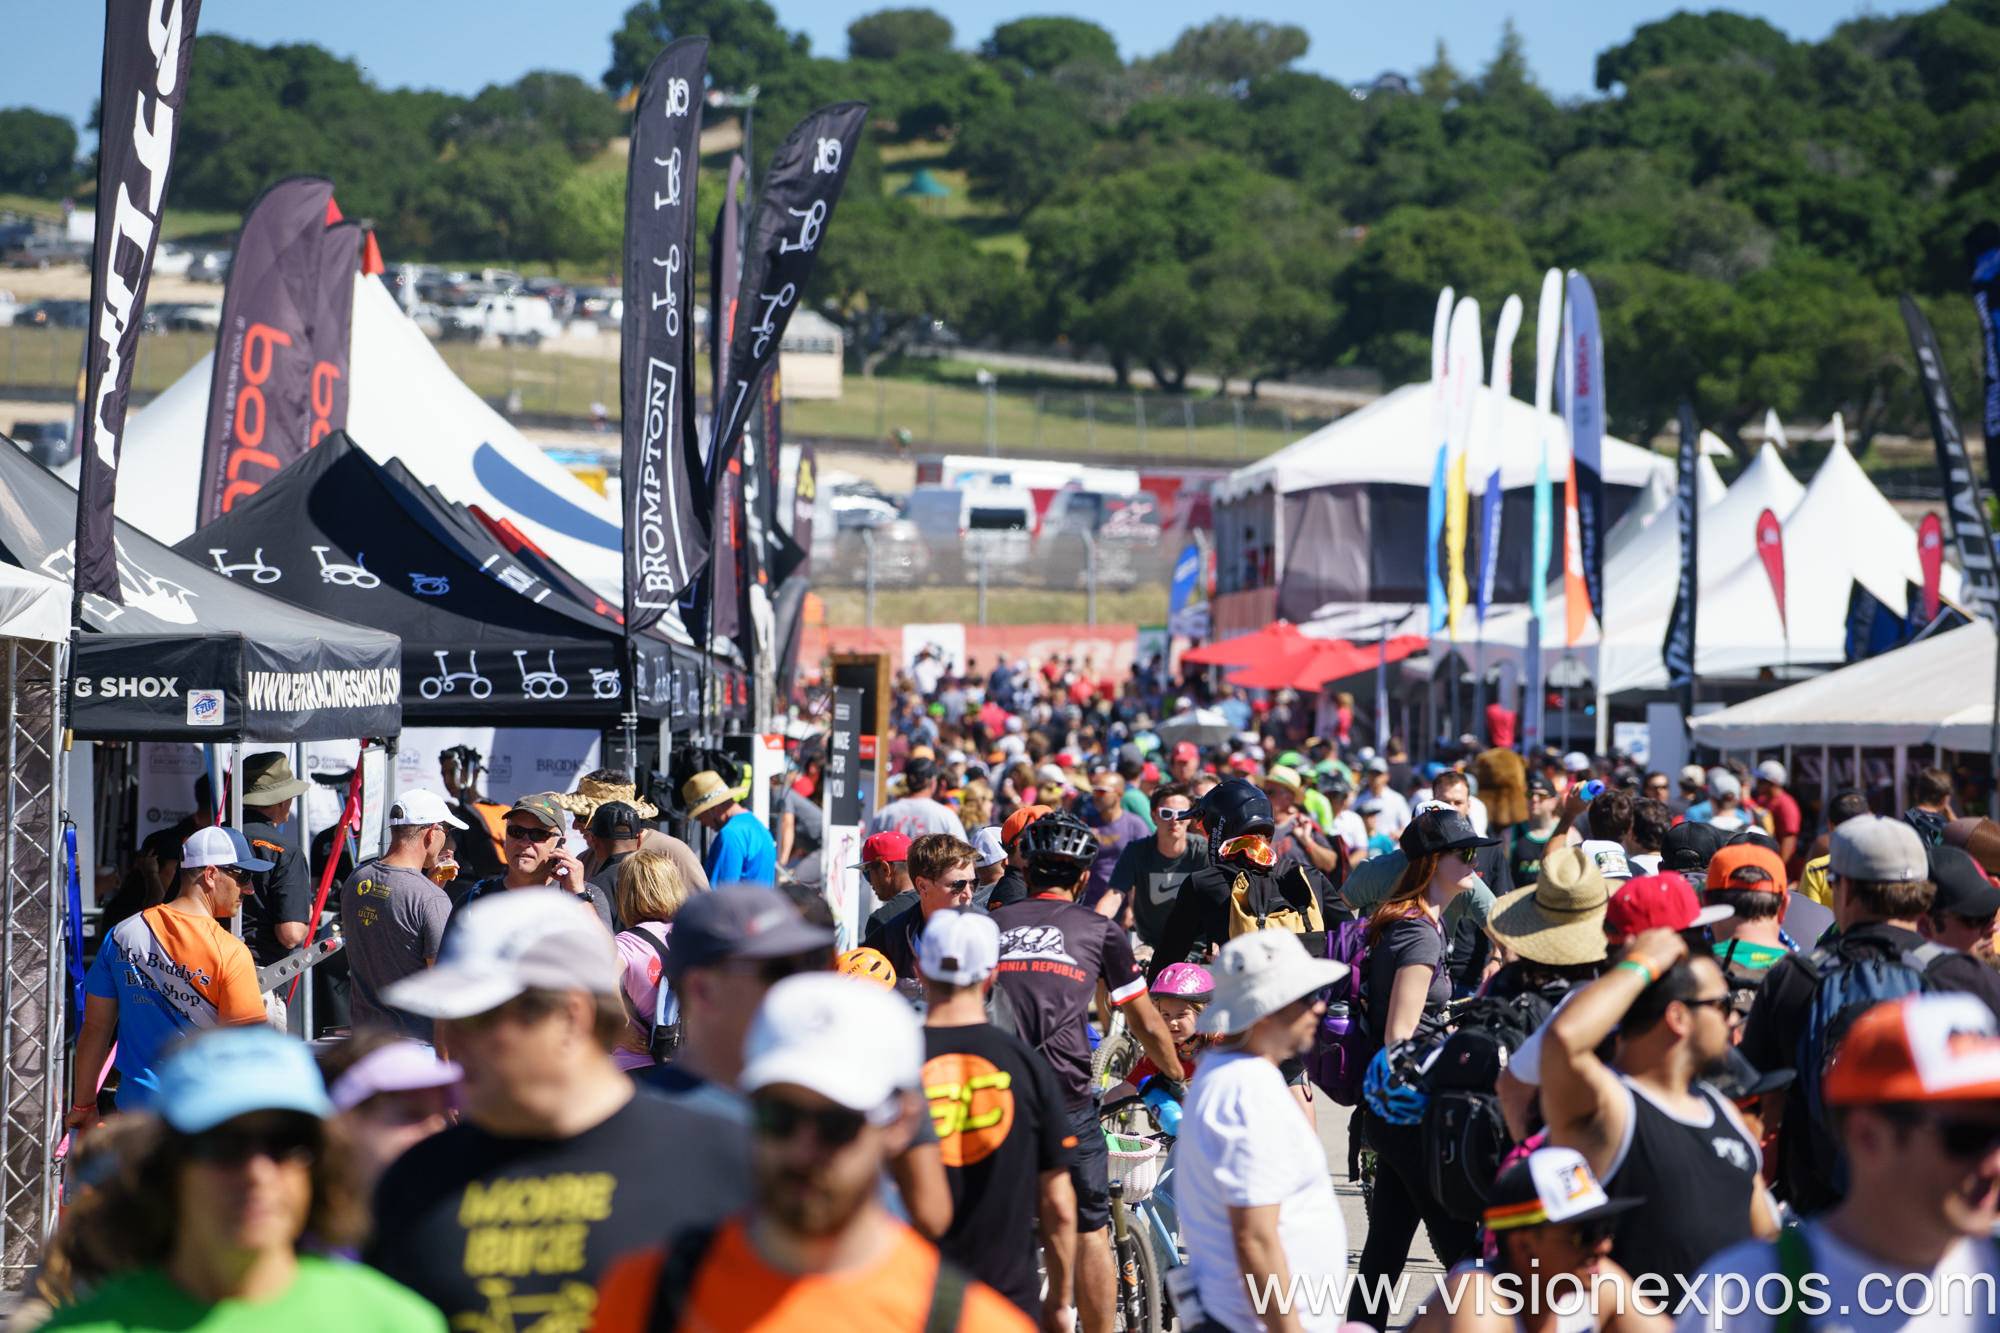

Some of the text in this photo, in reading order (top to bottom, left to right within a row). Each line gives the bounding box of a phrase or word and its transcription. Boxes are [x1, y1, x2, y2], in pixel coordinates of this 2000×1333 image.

[641, 377, 675, 594] BROMPTON
[99, 676, 179, 698] SHOX
[146, 951, 211, 986] Buddy's
[1031, 960, 1087, 982] REPUBLIC
[125, 970, 159, 992] Bike
[161, 981, 201, 1007] Shop
